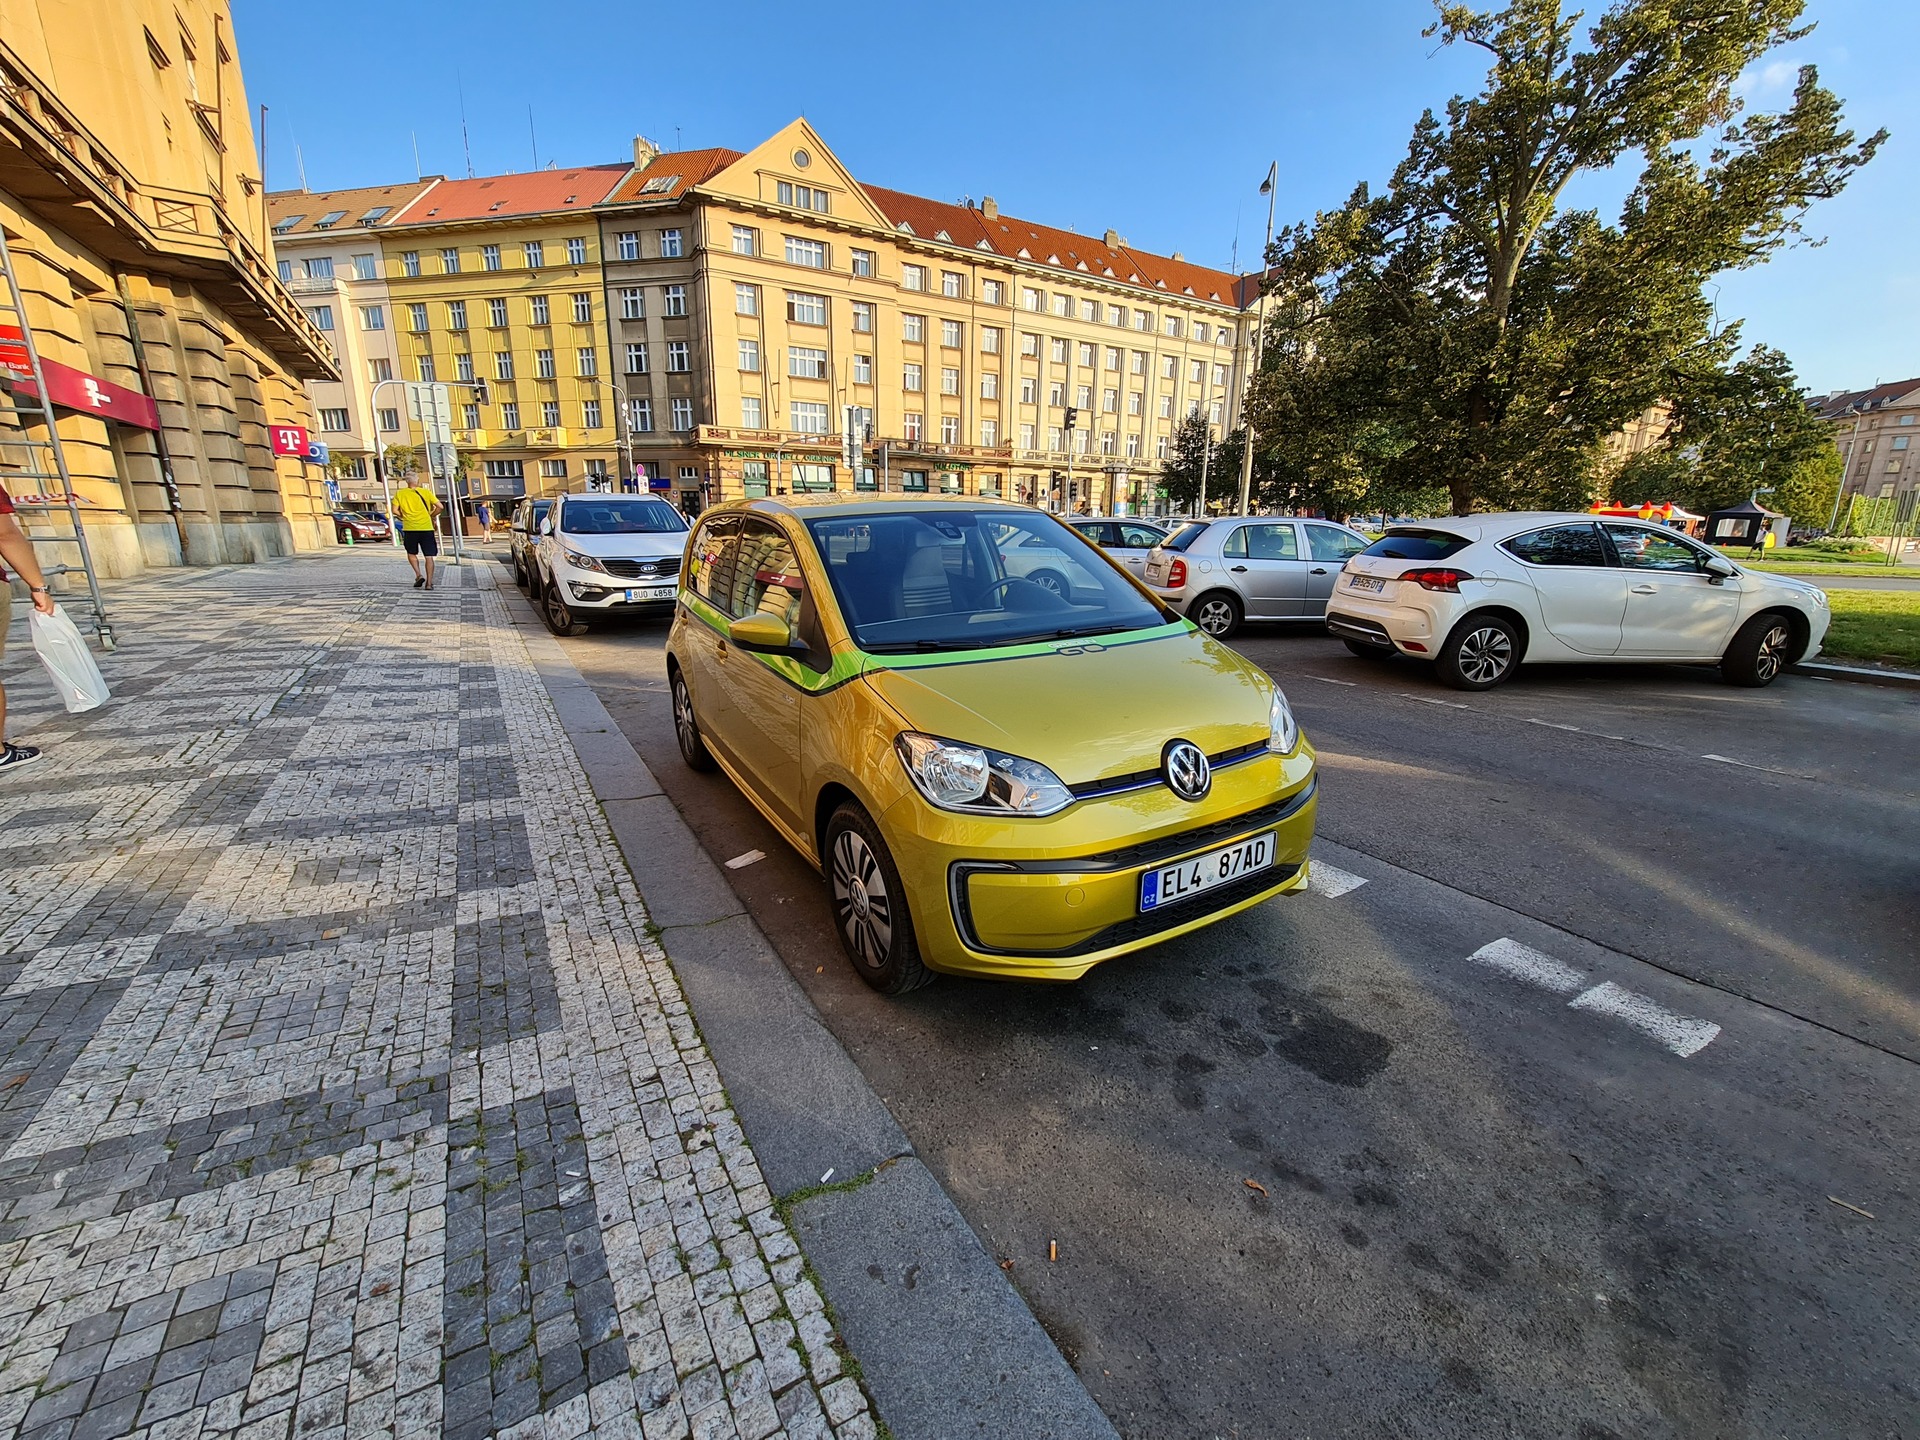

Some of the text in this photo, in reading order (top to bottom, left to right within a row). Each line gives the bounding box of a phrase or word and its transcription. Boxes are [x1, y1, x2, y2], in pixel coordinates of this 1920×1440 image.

[8, 361, 30, 371] Bank
[279, 430, 300, 451] T
[724, 450, 760, 459] PILSNER
[654, 589, 673, 598] 4858
[1162, 840, 1266, 899] EL4 87AD
[1143, 893, 1156, 904] CZ
